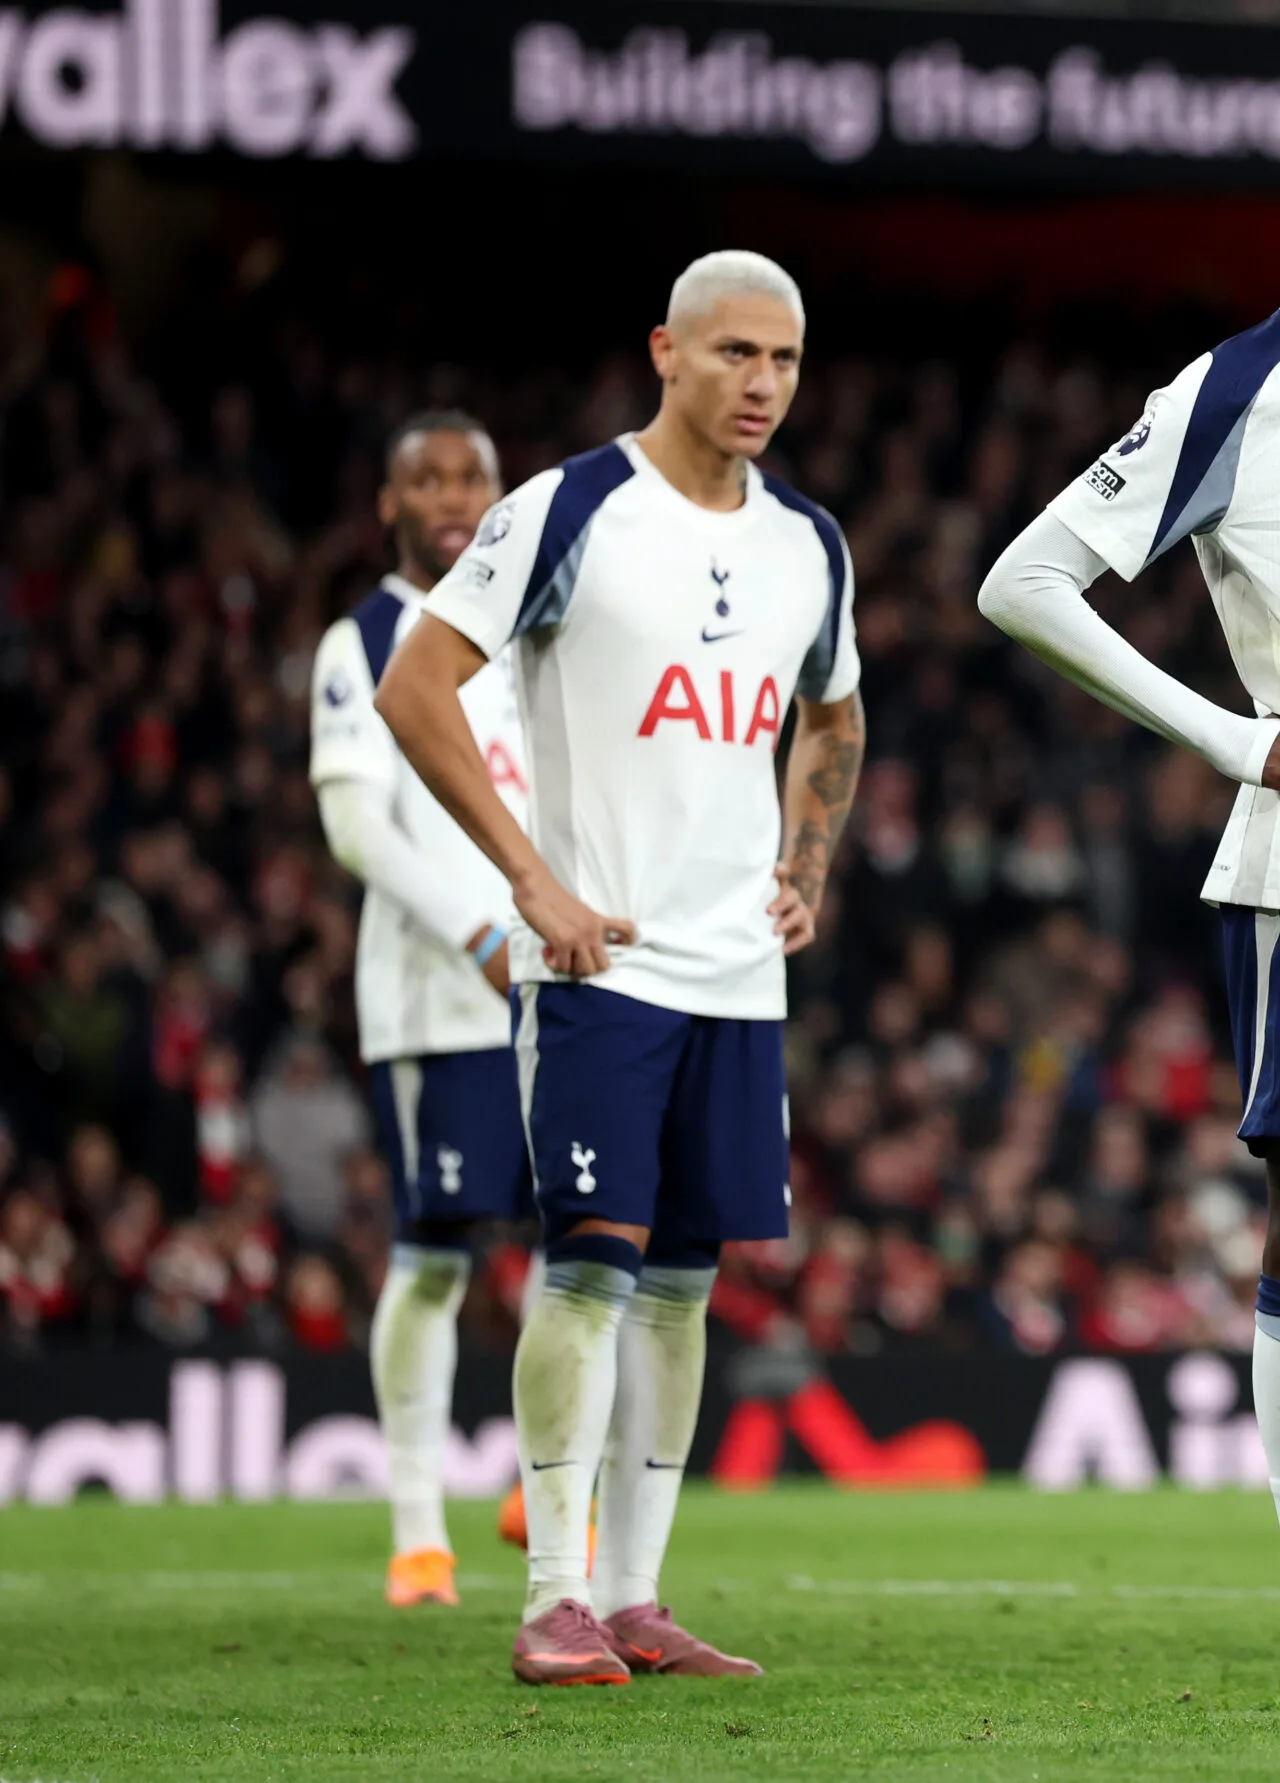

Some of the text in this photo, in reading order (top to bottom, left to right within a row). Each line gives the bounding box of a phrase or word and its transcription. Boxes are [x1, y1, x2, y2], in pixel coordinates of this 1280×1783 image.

[0, 0, 415, 160] allex
[512, 22, 880, 162] Building
[891, 40, 1041, 149] the
[637, 664, 780, 753] AIA
